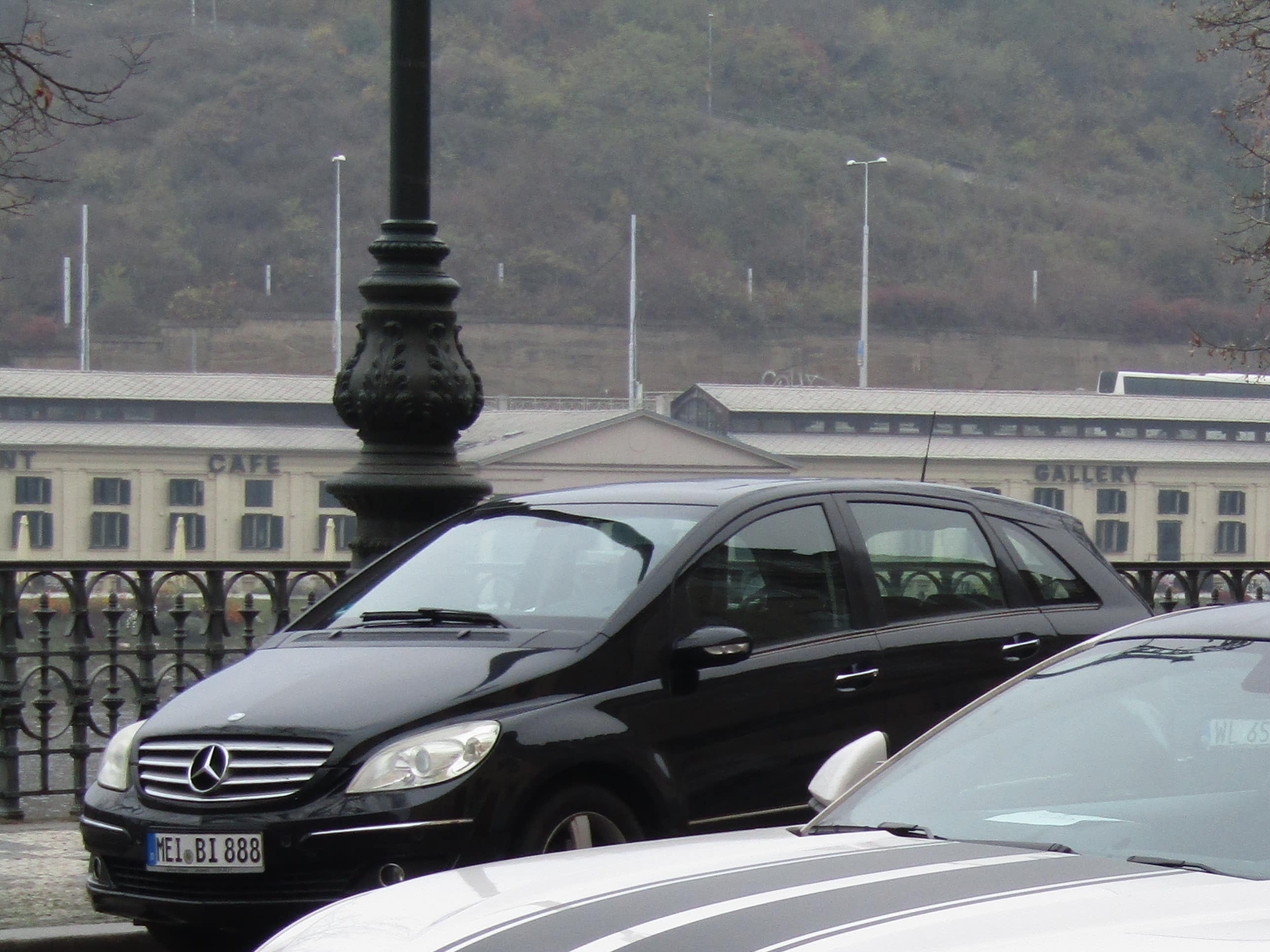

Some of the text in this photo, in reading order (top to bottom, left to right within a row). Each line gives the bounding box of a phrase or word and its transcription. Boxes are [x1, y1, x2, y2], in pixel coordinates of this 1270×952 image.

[208, 453, 281, 474] CAFE
[1035, 464, 1138, 483] GALLERY
[157, 837, 260, 863] MEI BI 888
